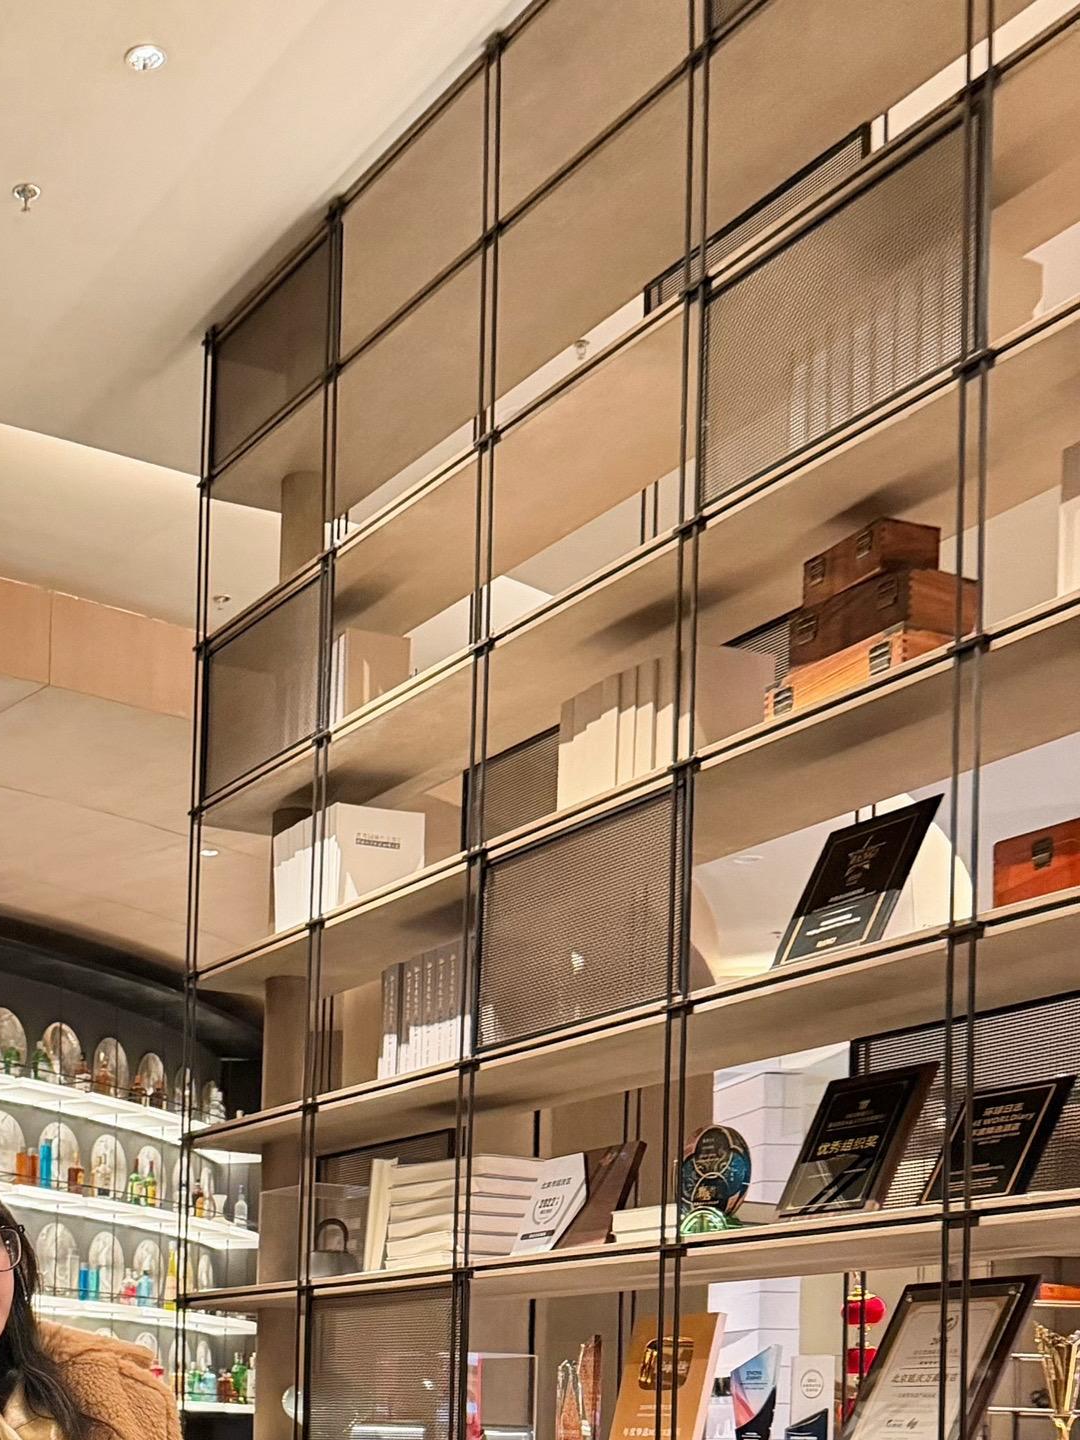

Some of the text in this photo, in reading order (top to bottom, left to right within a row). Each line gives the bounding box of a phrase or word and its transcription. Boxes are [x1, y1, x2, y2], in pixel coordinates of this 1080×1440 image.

[816, 1134, 880, 1157] 优秀组织奖
